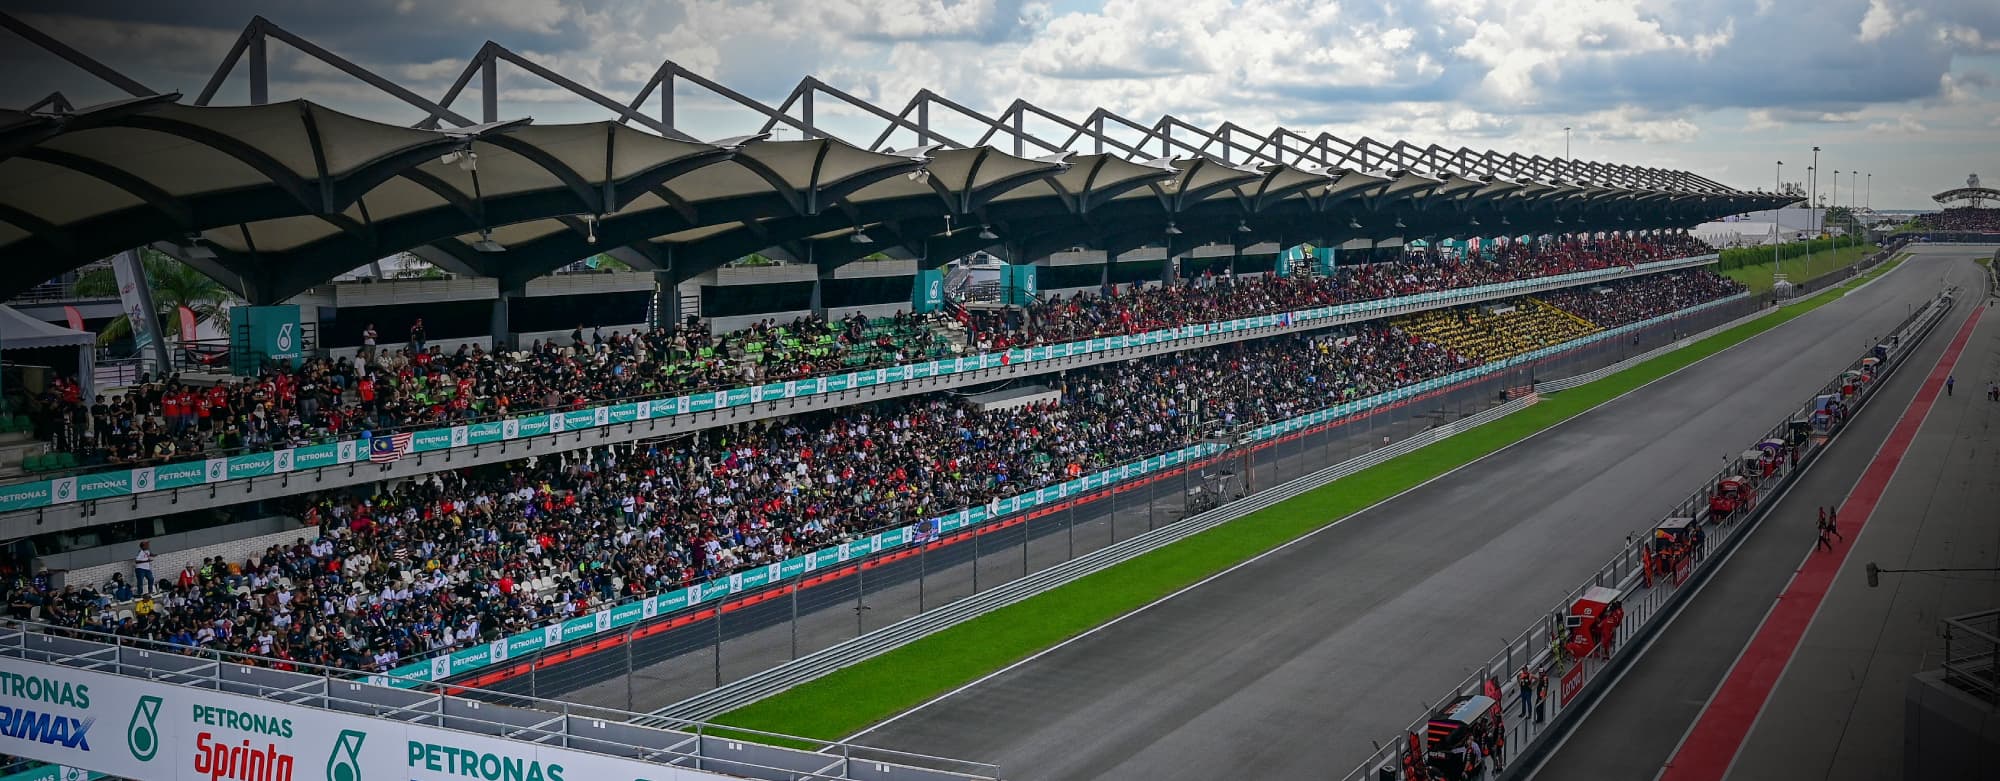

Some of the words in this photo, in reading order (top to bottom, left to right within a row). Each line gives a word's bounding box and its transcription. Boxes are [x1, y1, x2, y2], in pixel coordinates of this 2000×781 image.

[416, 435, 449, 445] PETRONAS
[470, 428, 500, 438] PETRONAS
[296, 451, 334, 462] PETRONAS
[230, 460, 271, 472] PETRONAS
[158, 469, 201, 481] PETRONAS
[81, 479, 128, 492] PETRONAS
[658, 595, 686, 609] PETRONAS
[612, 608, 641, 622] PETRONAS
[563, 621, 594, 635] PETRONAS
[510, 636, 544, 650] PETRONAS
[453, 652, 488, 667] PETRONAS
[193, 704, 293, 739] PETRONAS
[408, 741, 564, 781] PETRONAS
